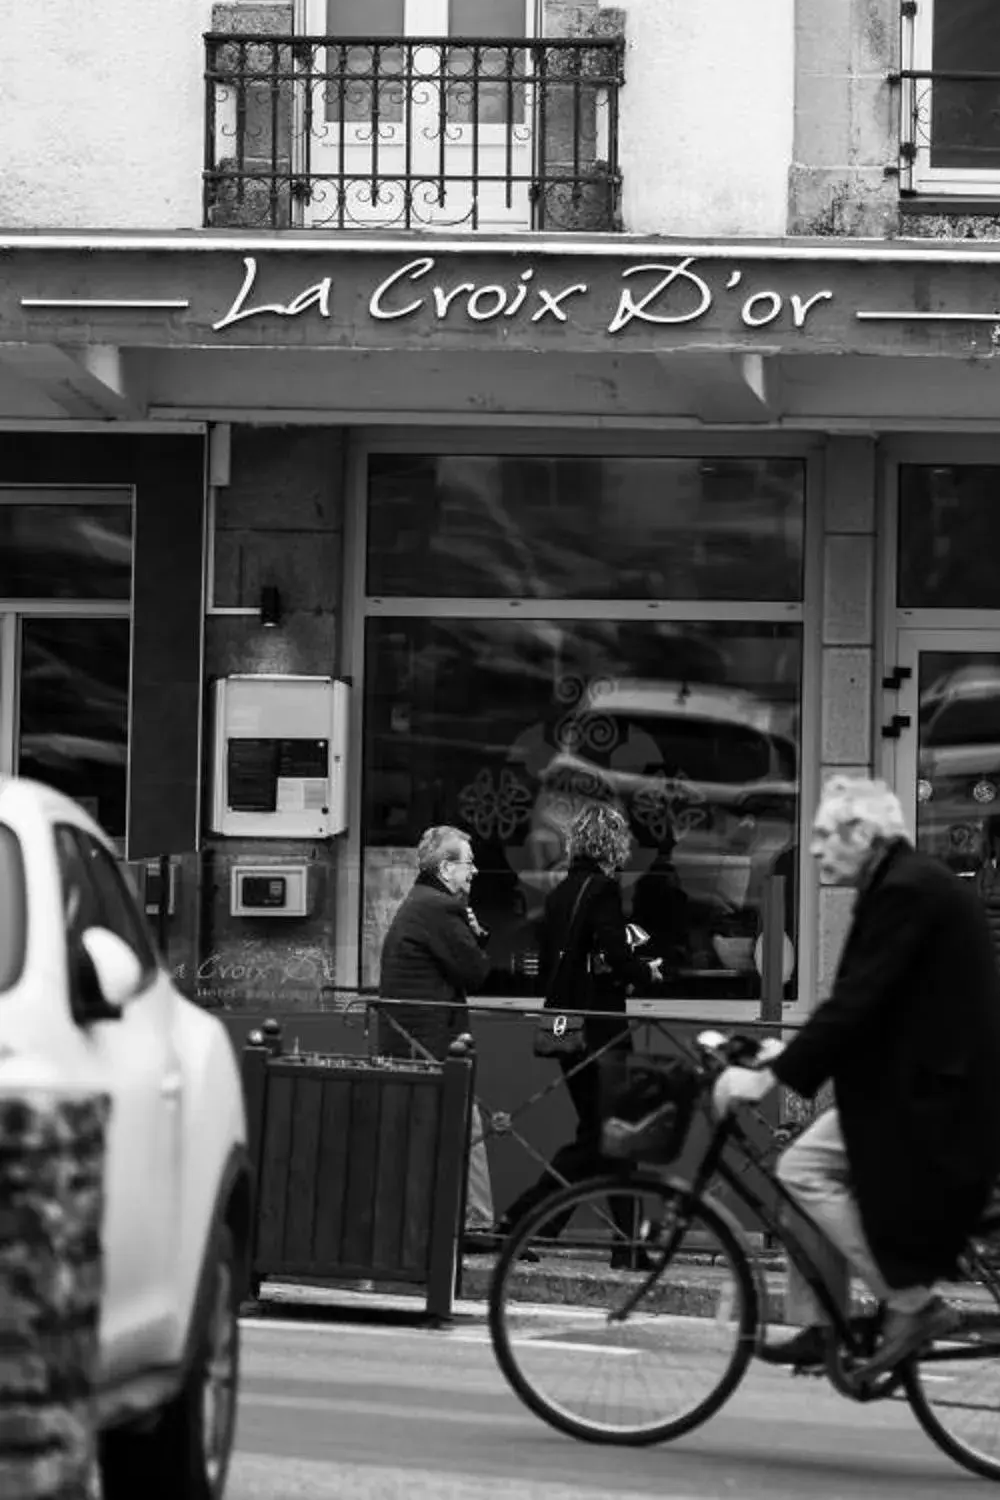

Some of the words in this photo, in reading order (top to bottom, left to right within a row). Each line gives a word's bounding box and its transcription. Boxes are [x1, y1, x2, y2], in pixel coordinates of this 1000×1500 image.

[212, 257, 332, 330] La
[369, 257, 587, 321] Croix
[607, 257, 833, 333] D'or
[197, 951, 274, 982] Croix
